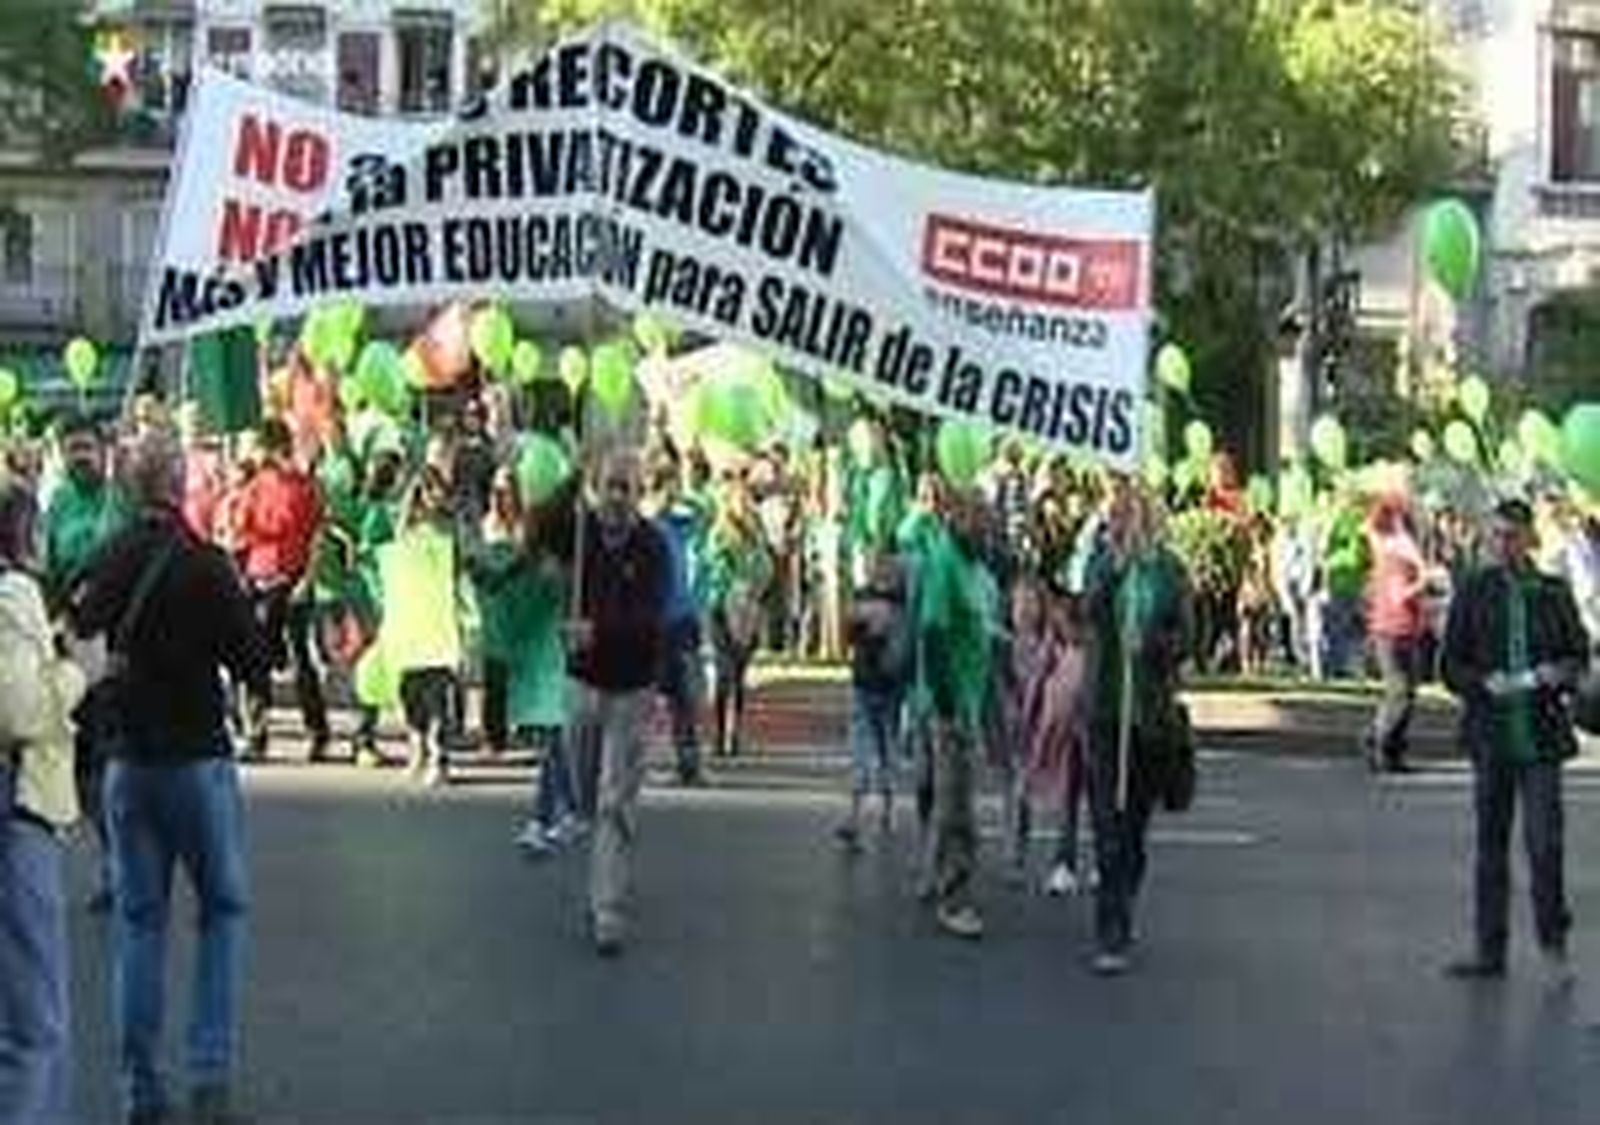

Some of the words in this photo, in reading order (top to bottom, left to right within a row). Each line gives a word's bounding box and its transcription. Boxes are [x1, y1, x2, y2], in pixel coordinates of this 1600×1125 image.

[235, 114, 330, 193] NO
[291, 221, 433, 298] MEJOR
[644, 250, 746, 327] para
[751, 276, 873, 374] SALIR
[874, 326, 934, 397] de
[937, 346, 984, 413] la
[990, 367, 1134, 454] CRISIS
